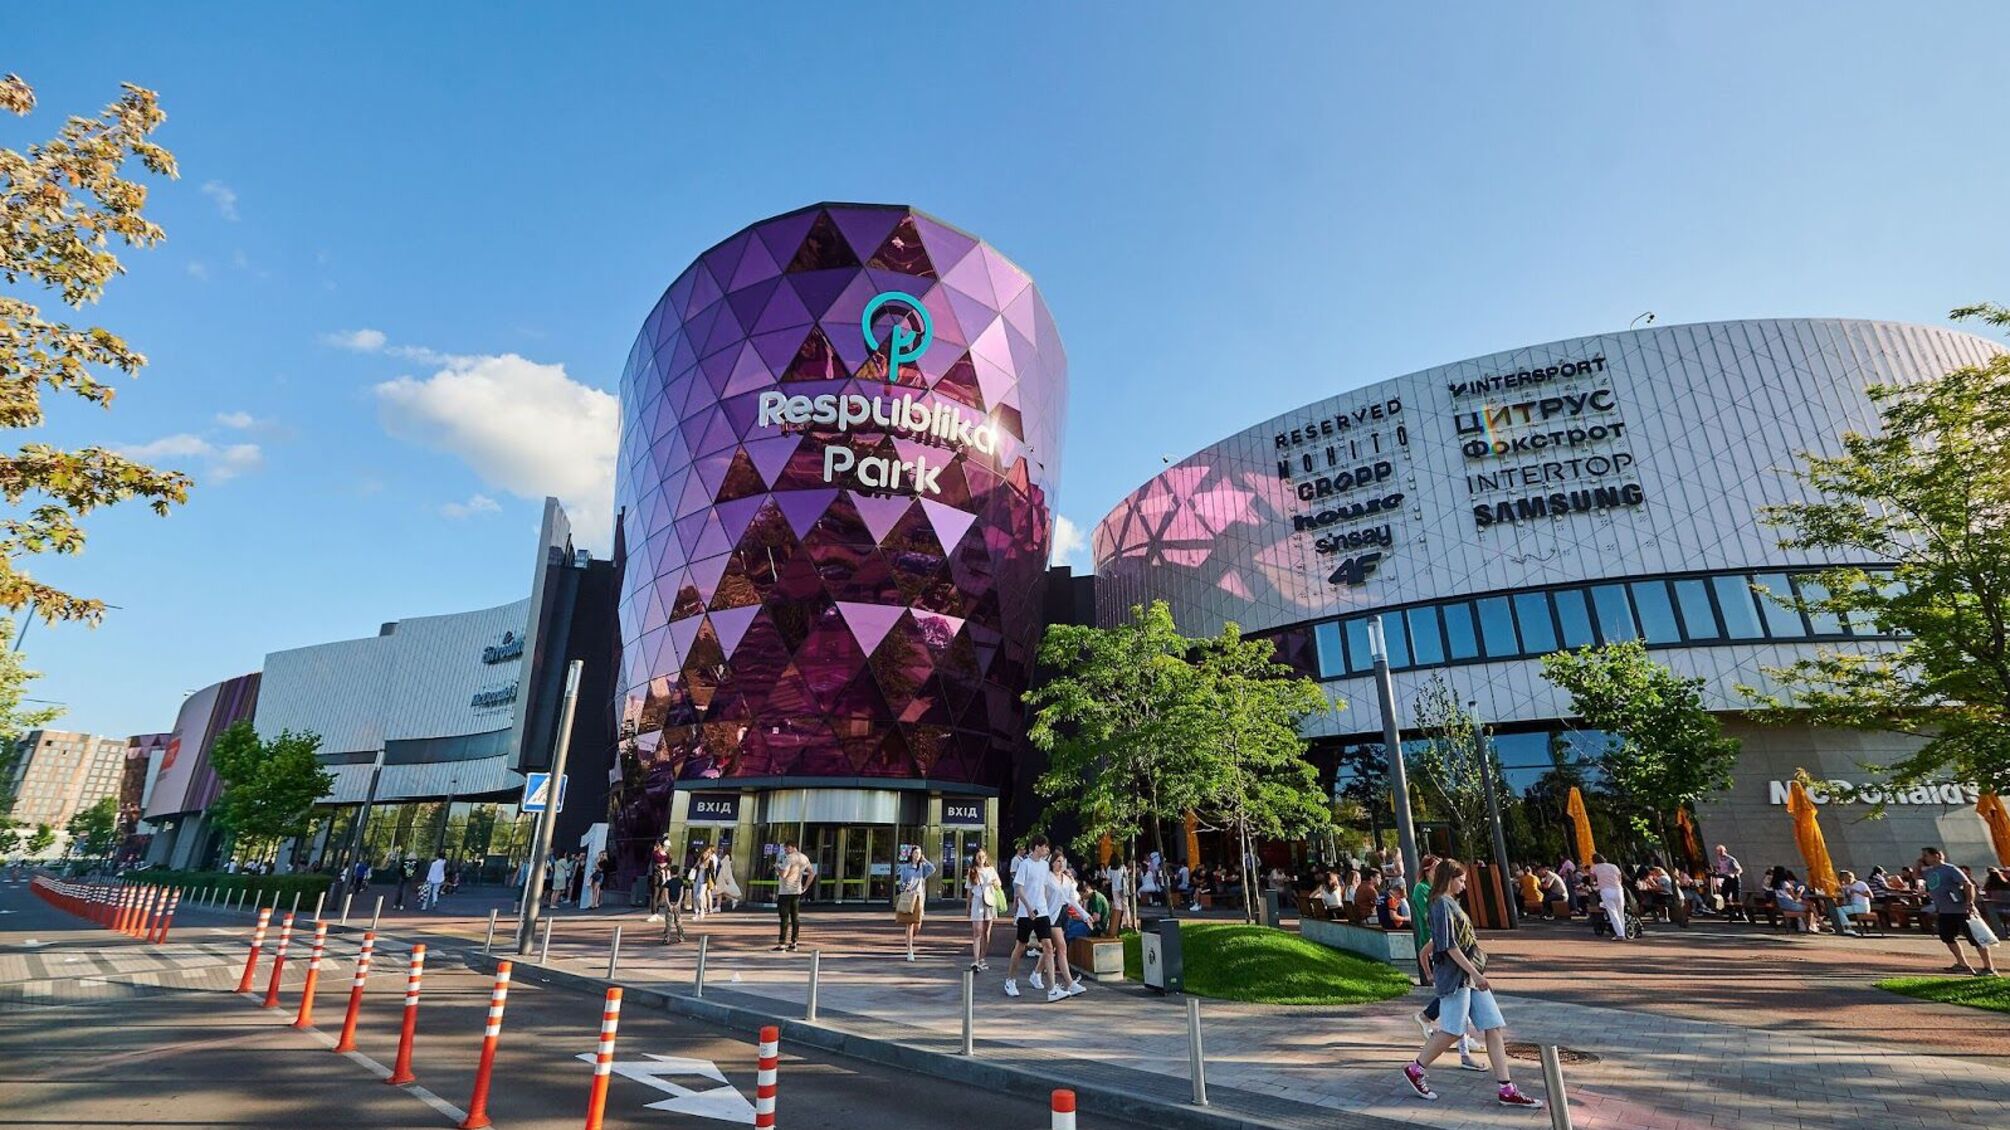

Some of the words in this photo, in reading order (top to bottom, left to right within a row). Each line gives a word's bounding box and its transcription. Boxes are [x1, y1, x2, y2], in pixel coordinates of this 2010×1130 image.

[1470, 358, 1605, 394] INTERSPORT
[759, 391, 996, 455] Respublika
[1275, 399, 1401, 449] RESERVED
[1455, 389, 1615, 434] ЦИТРУС
[824, 446, 941, 494] Park
[1297, 461, 1391, 501] CROPP
[1467, 453, 1632, 494] INTERTOP
[1473, 483, 1643, 526] SAMSUNG
[1328, 552, 1382, 585] 4F
[697, 801, 732, 815] ВХІД
[947, 806, 978, 819] ВХІД
